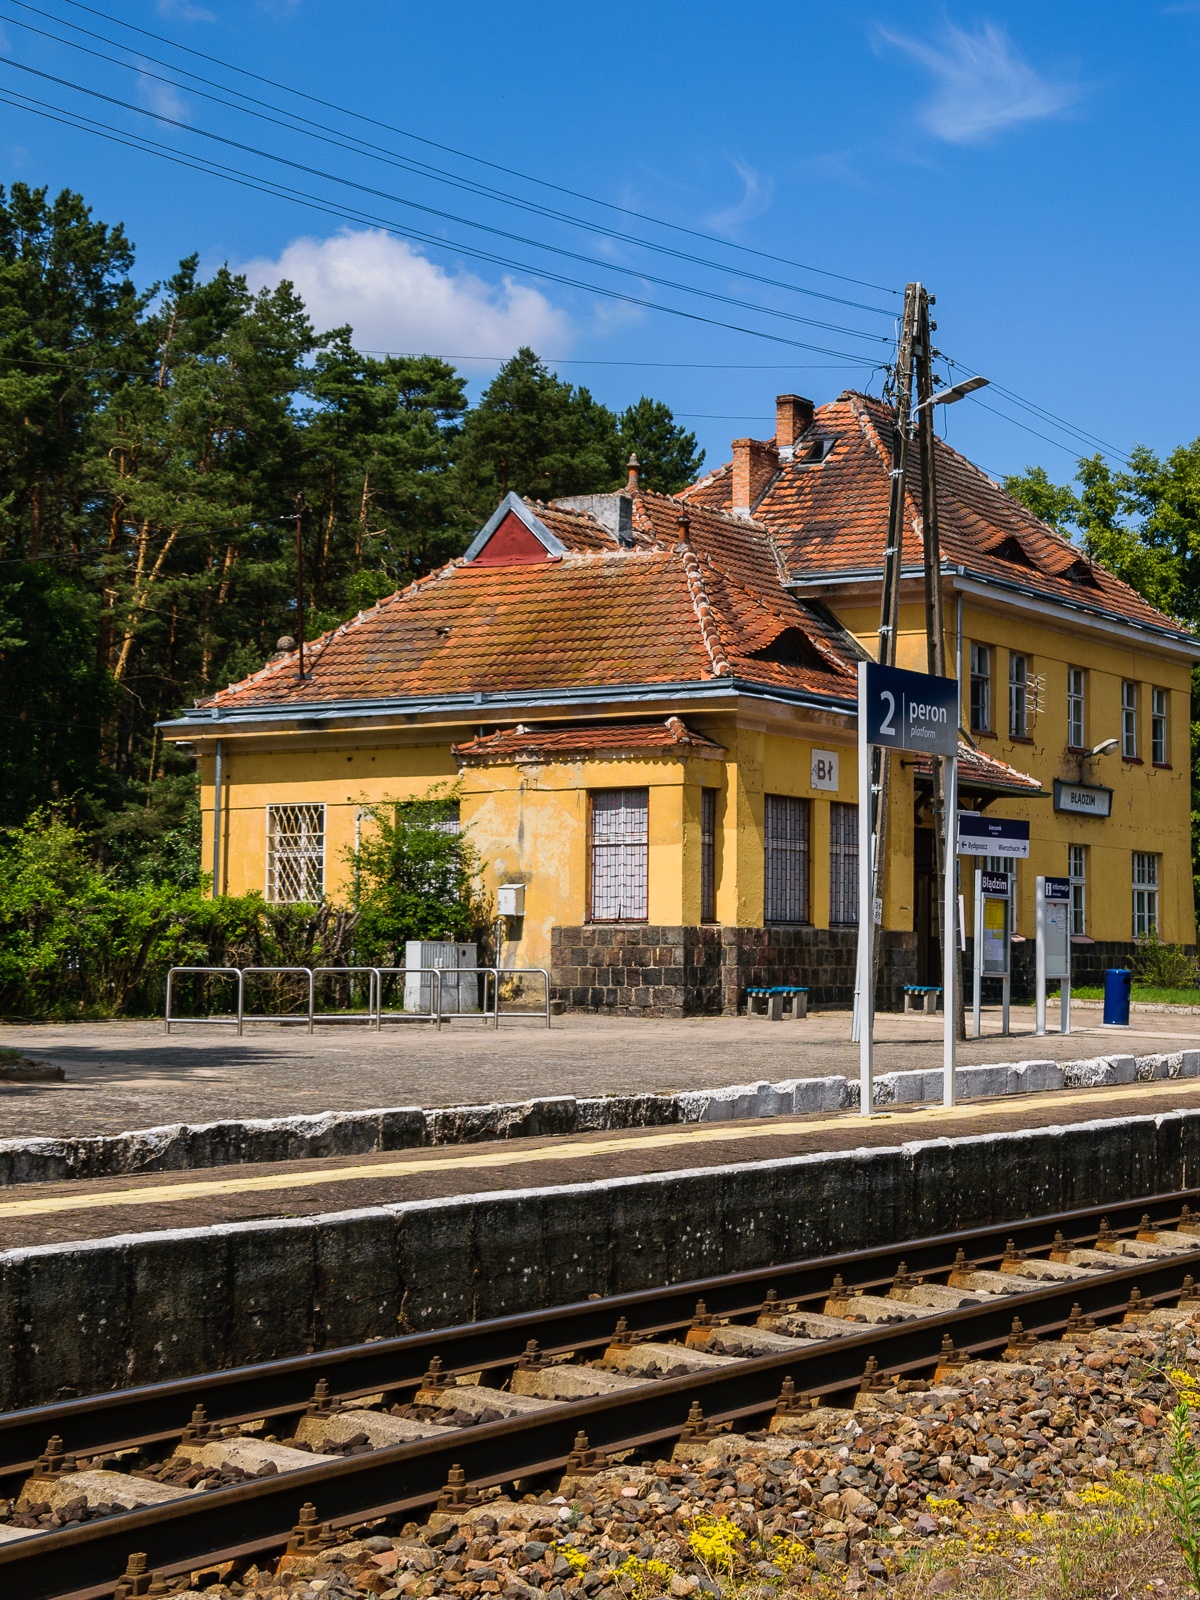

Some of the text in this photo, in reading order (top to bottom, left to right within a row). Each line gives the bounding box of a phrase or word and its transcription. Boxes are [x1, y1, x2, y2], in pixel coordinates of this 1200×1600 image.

[879, 690, 947, 736] 2 peron
[910, 724, 937, 739] platform
[817, 758, 834, 782] Bł
[1070, 791, 1096, 807] BŁĄDZIM
[967, 841, 989, 851] Bydgoszcz
[997, 843, 1021, 852] Wierzchucin
[982, 876, 1008, 892] Błądzim
